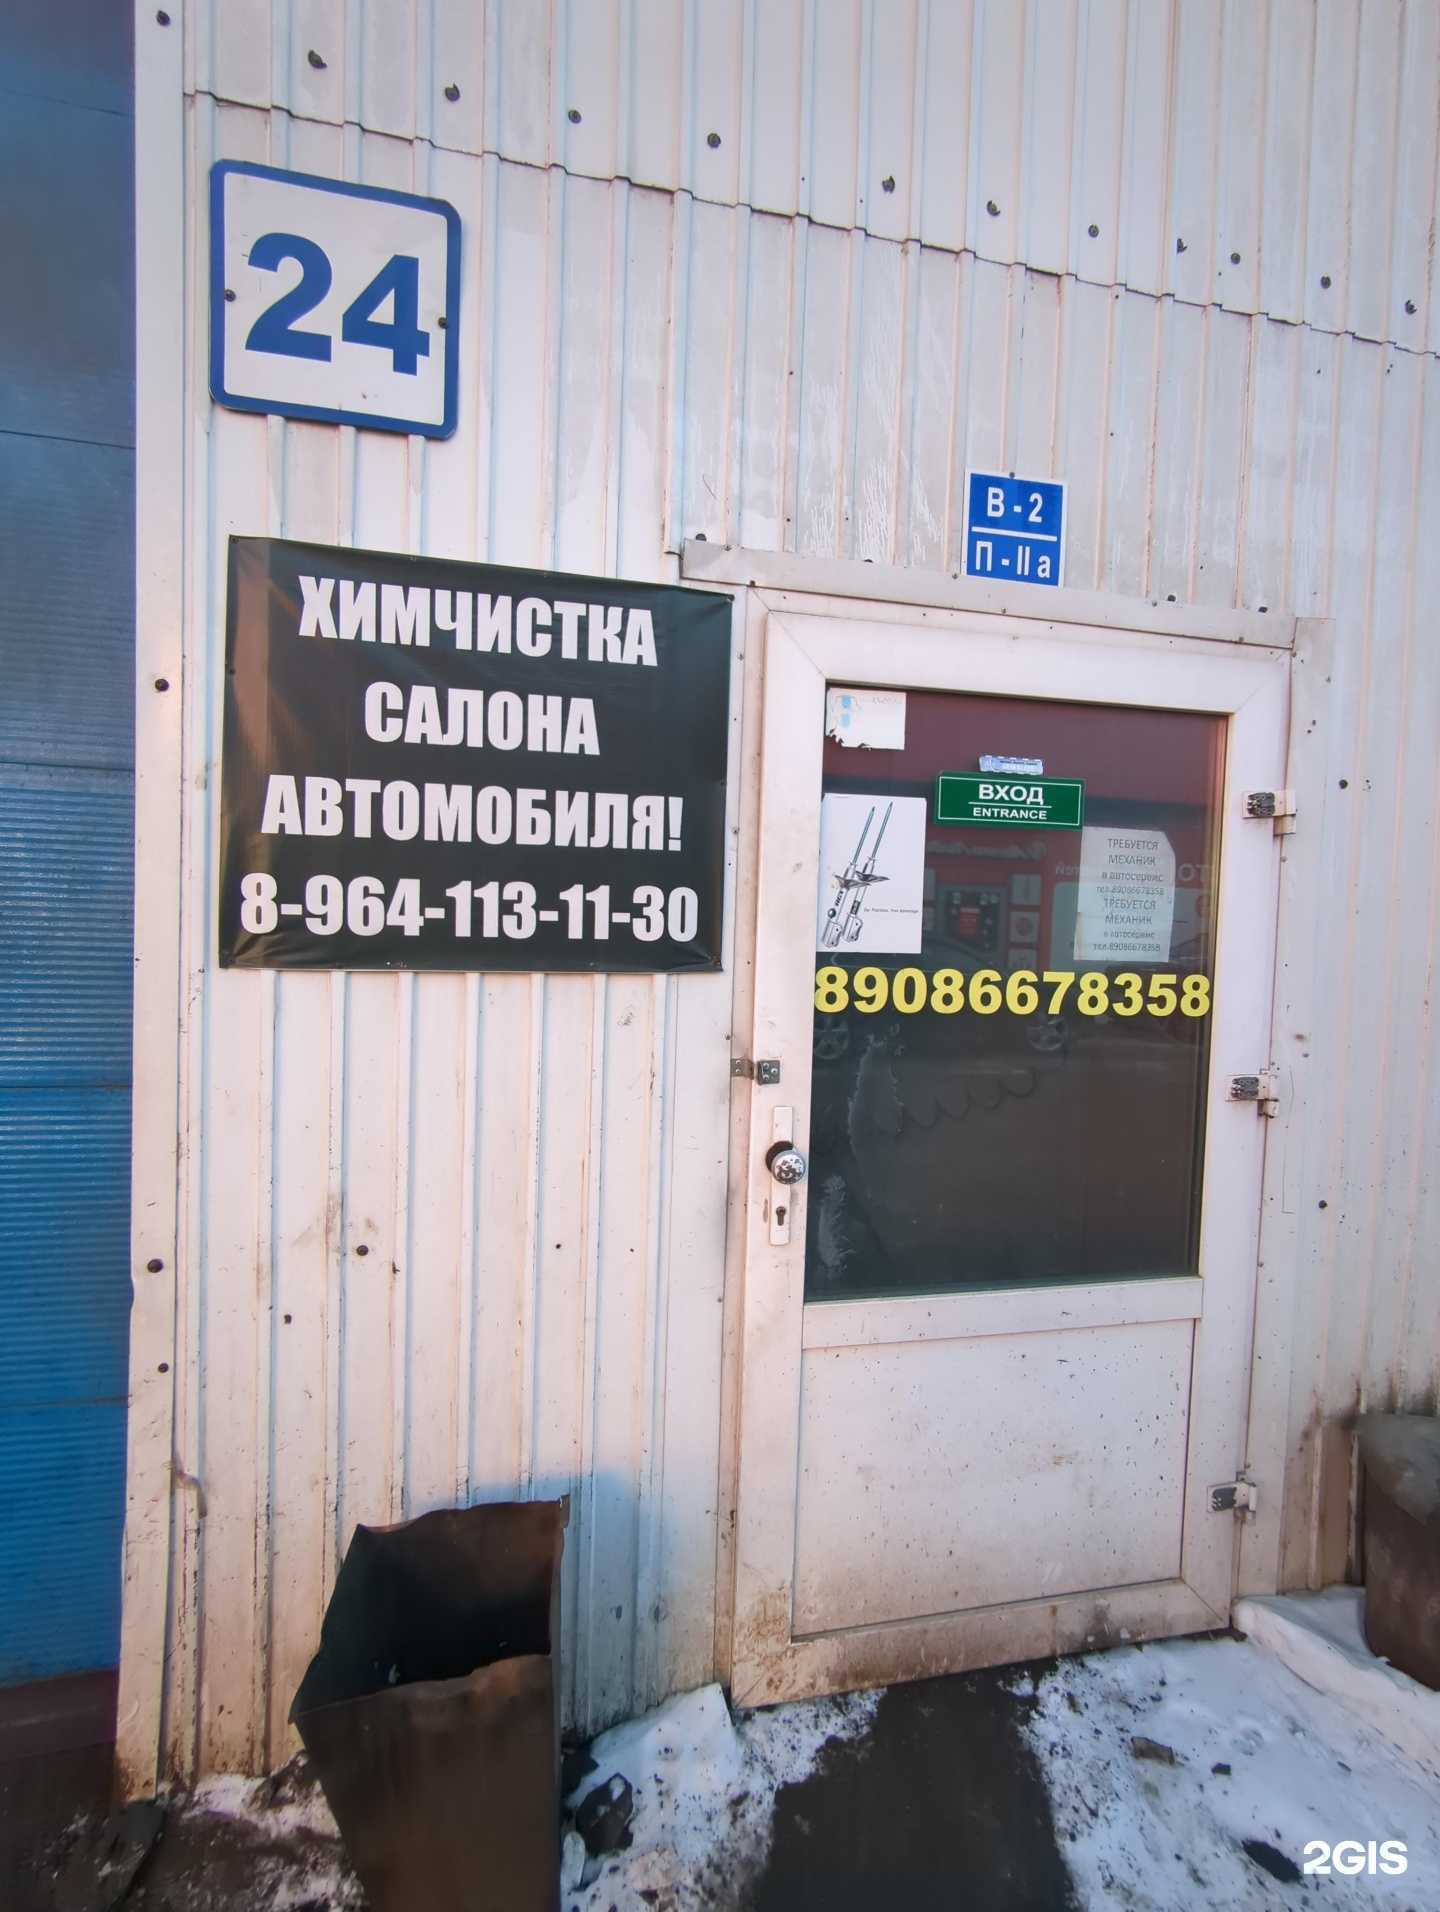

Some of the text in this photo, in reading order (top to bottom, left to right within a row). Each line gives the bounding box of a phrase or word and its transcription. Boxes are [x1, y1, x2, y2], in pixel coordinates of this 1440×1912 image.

[245, 232, 430, 376] 24
[298, 575, 658, 667] ХИМЧИСТКА
[365, 681, 600, 755] САЛОНА
[261, 774, 684, 851] АВТОМОБИЛЯ!
[978, 783, 1044, 806] ВХОД
[972, 807, 1048, 820] ENTRANCE
[1107, 838, 1160, 850] ТРЕБУЕТСЯ
[1108, 854, 1156, 866] МЕХАНИК
[240, 872, 699, 942] 8-964-113-11-30
[1103, 898, 1157, 910] ТРЕБУЕТСЯ
[1104, 913, 1152, 925] МЕХАНИК
[814, 966, 1211, 1018] 89086678358
